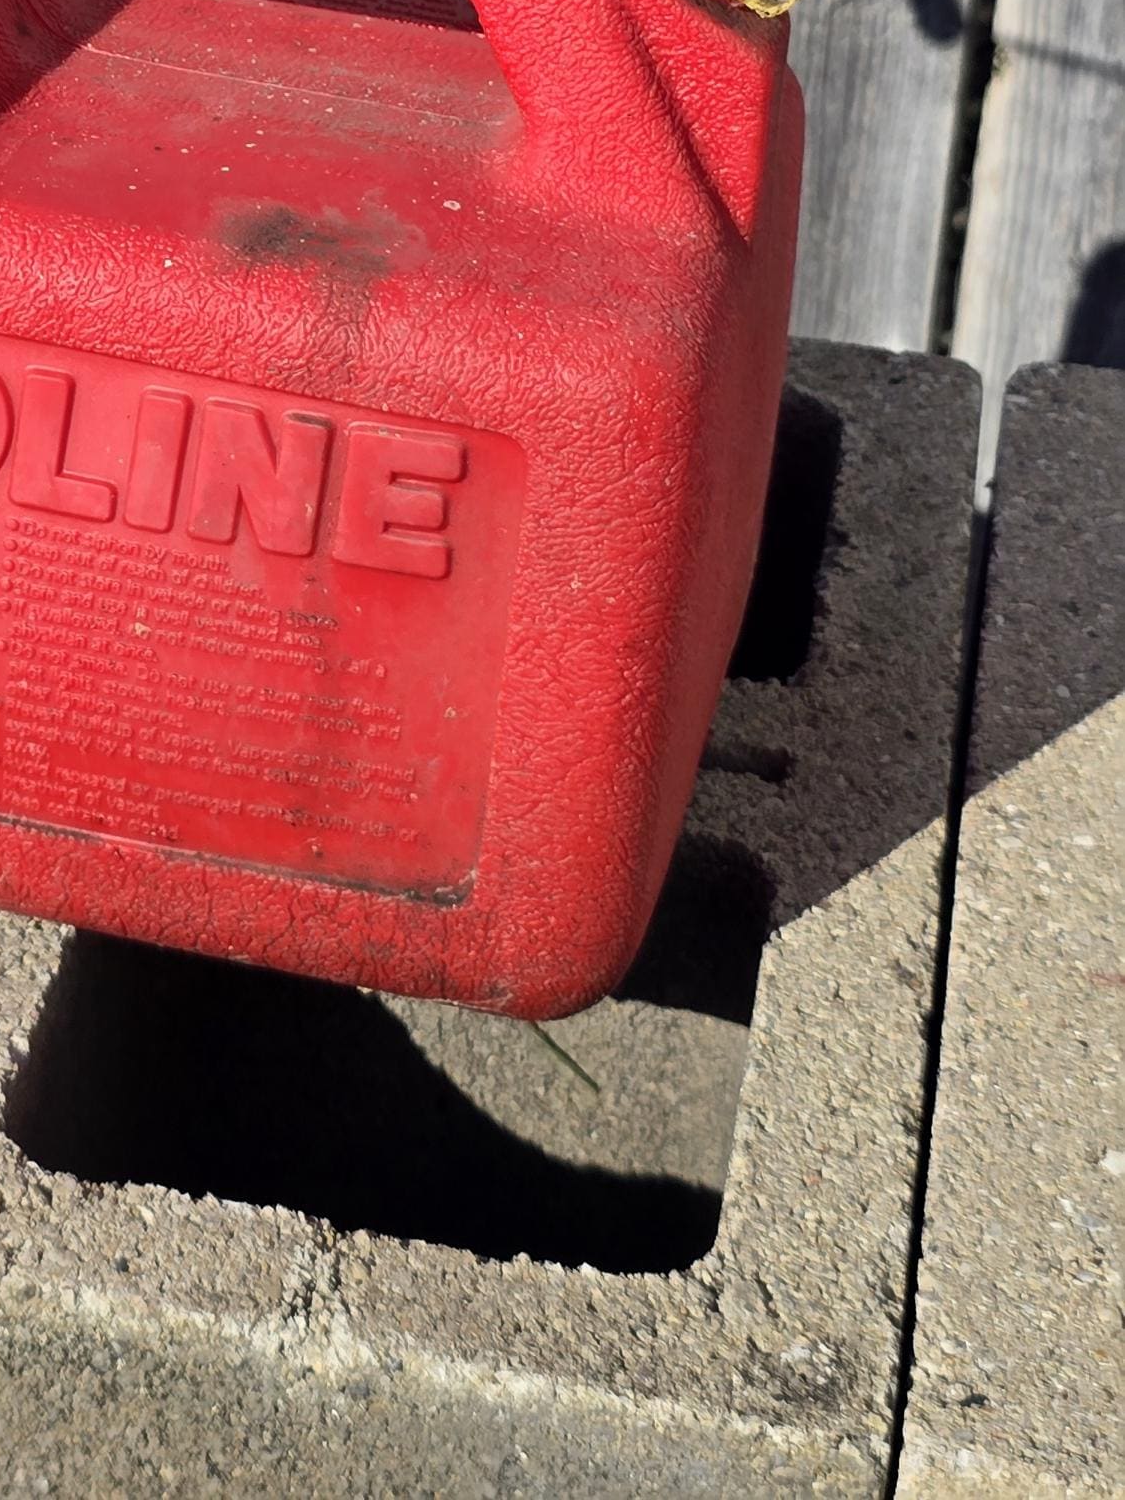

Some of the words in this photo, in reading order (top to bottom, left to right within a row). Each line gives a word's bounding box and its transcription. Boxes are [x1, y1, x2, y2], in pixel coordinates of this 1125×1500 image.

[16, 538, 62, 567] Keep
[63, 547, 96, 570] out
[96, 553, 119, 574] of
[119, 557, 169, 583] reach
[169, 566, 192, 587] of
[21, 518, 50, 540] Do
[49, 524, 82, 546] not
[82, 530, 143, 562] siphon
[143, 542, 168, 566] by
[16, 558, 45, 581] Do
[44, 564, 78, 587] not
[78, 570, 124, 596] store
[125, 578, 146, 598] in
[145, 581, 208, 610] vehicle
[209, 595, 232, 615] or
[232, 597, 285, 627] living
[58, 587, 96, 610] and
[99, 595, 129, 616] use
[152, 603, 193, 627] well
[153, 625, 187, 648] not
[188, 631, 250, 660] induce
[372, 661, 389, 680] a
[38, 645, 71, 667] not
[133, 662, 164, 684] Do
[166, 669, 197, 691] not
[200, 675, 233, 698] use
[233, 682, 256, 702] or
[256, 684, 303, 710] store
[52, 687, 122, 722] ignition
[67, 709, 136, 743] buildup
[136, 722, 158, 742] of
[353, 755, 418, 789] ignited
[93, 734, 118, 759] by
[120, 740, 135, 759] a
[185, 751, 210, 772] or
[363, 718, 403, 744] and
[52, 762, 131, 798] repeated
[128, 779, 153, 800] or
[151, 780, 245, 822] prolonged
[396, 823, 421, 844] or
[81, 788, 102, 811] of
